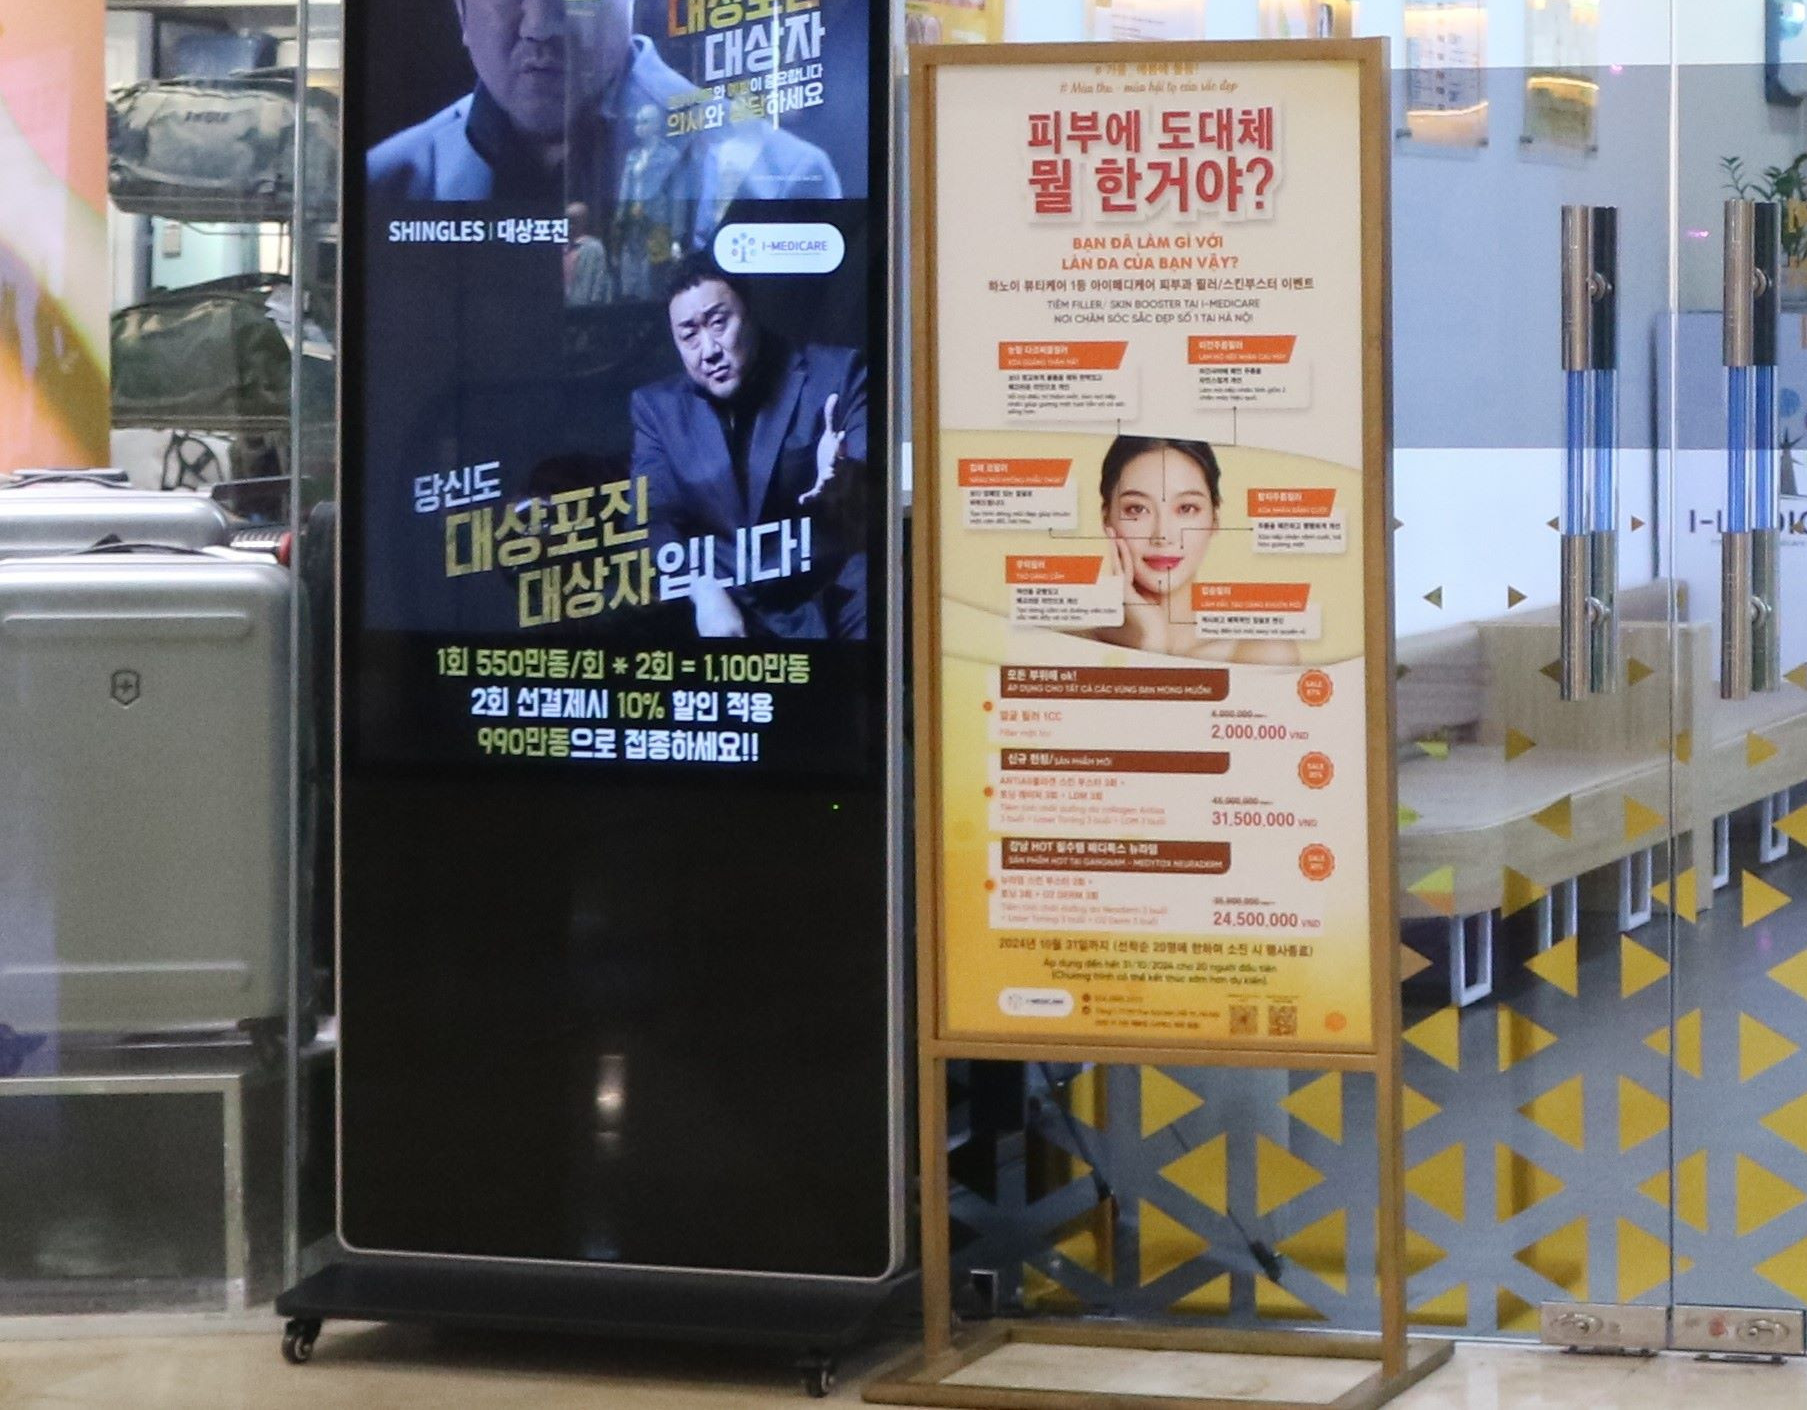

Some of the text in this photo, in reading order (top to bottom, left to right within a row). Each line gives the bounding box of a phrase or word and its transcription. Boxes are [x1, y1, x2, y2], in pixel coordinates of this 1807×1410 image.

[703, 12, 825, 81] 대상자
[1028, 105, 1274, 154] 피부에 도대체
[1028, 156, 1275, 214] 뭘 한거야?
[388, 217, 569, 244] SHINGLES 대상포진
[1072, 236, 1105, 254] BẠN
[1138, 233, 1170, 250] LÀM
[1174, 232, 1191, 249] GÌ
[1196, 232, 1224, 248] VỚI
[761, 239, 829, 253] I-MEDICARE
[1061, 254, 1093, 271] LÀN
[1097, 257, 1118, 270] DA
[1124, 253, 1153, 270] CỦA
[1160, 257, 1192, 272] BẠN
[988, 279, 1020, 292] 하노이
[1160, 279, 1192, 291] 피부과
[1281, 277, 1314, 290] 이벤트
[1110, 300, 1132, 309] SKIN
[1134, 300, 1181, 310] BOOSTER
[1201, 300, 1260, 310] I-MEDICARE
[413, 461, 502, 514] 당신도
[445, 475, 649, 577] 대상포진
[518, 516, 812, 629] 대상자입니다!
[437, 646, 469, 677] 1회
[476, 647, 605, 679] 550만동/회
[635, 652, 673, 680] 2회
[471, 687, 773, 723] 2회 선결제시 10% 할인 적용
[478, 728, 759, 762] 990만동으로 접종하세요!!
[1212, 812, 1295, 827] 31.500.000
[1031, 842, 1053, 853] HOT
[1083, 858, 1125, 867] GANGNAM
[1213, 912, 1298, 928] 24.500.000
